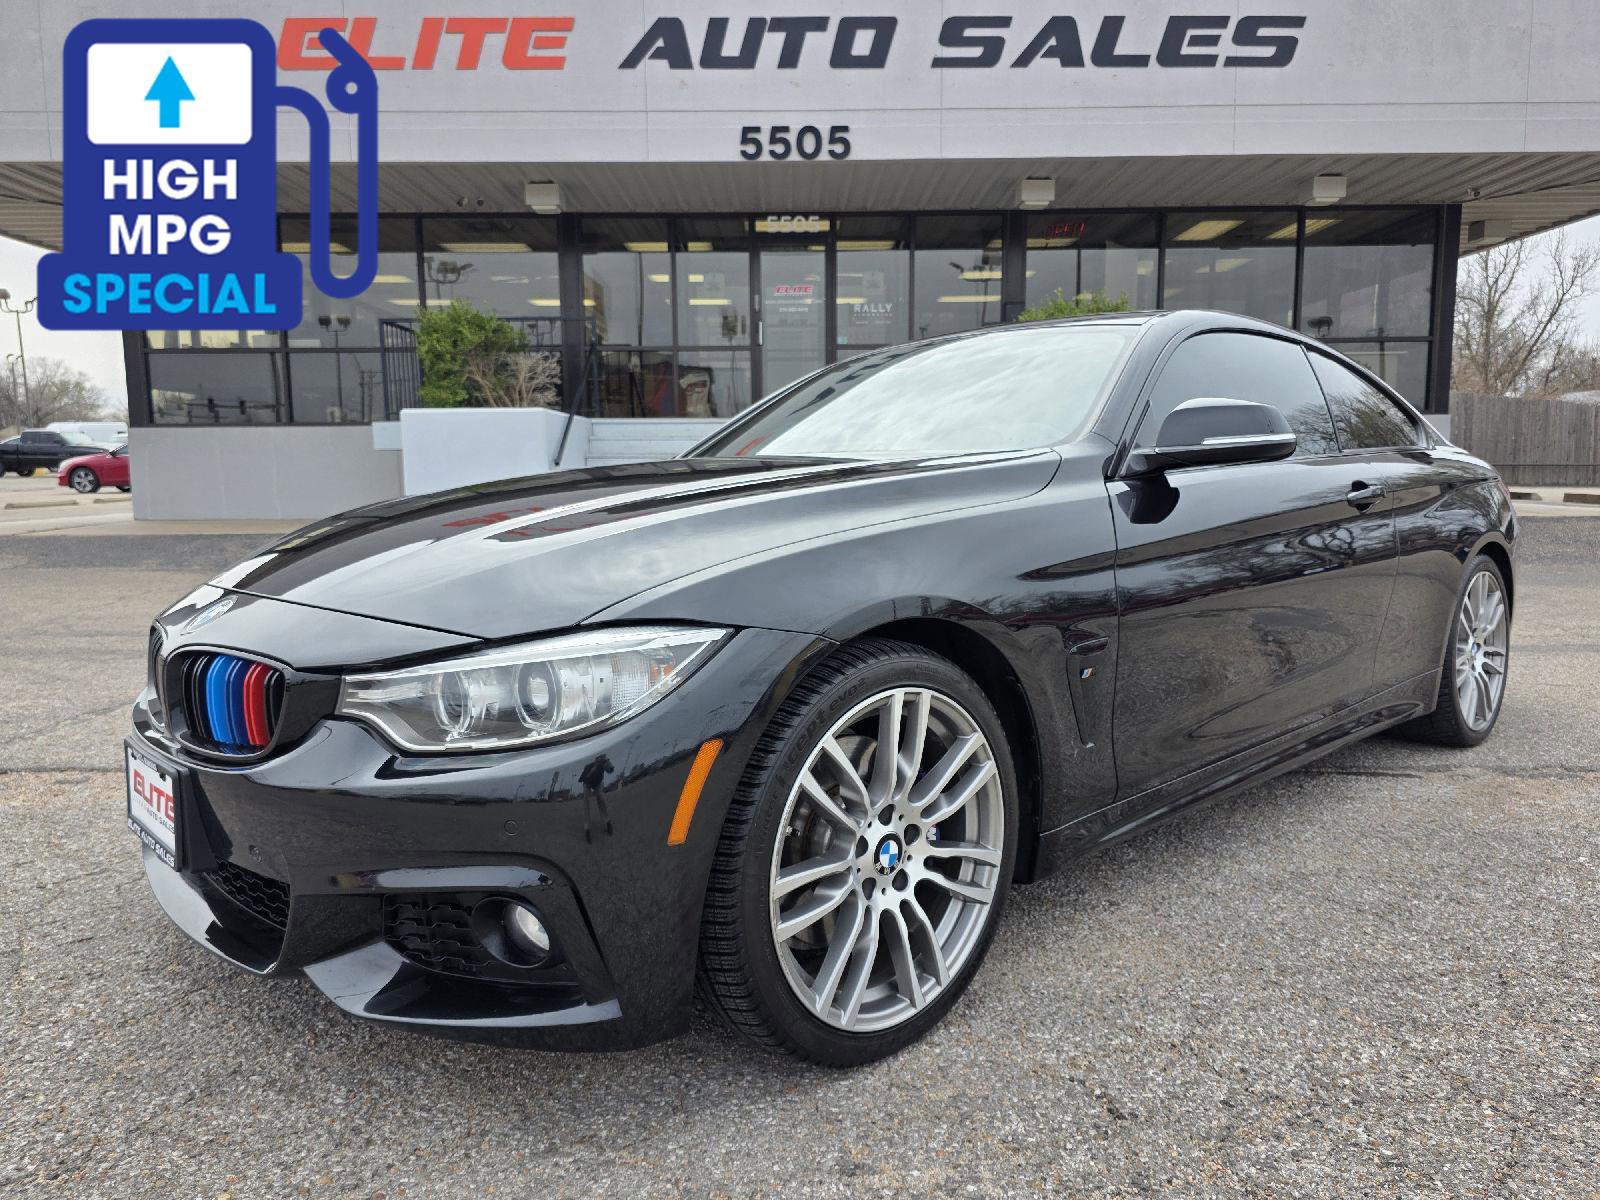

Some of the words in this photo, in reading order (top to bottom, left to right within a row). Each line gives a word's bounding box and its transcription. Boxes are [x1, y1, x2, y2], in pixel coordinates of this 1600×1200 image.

[277, 17, 575, 70] ELITE
[618, 16, 898, 70] AUTO
[932, 15, 1307, 68] SALES
[740, 125, 852, 161] 5505
[766, 215, 820, 233] 5505
[853, 303, 893, 313] RALLY
[133, 769, 175, 823] ELITE
[128, 819, 141, 836] ELITE
[140, 831, 156, 850] AUTO
[155, 843, 176, 868] SALES
